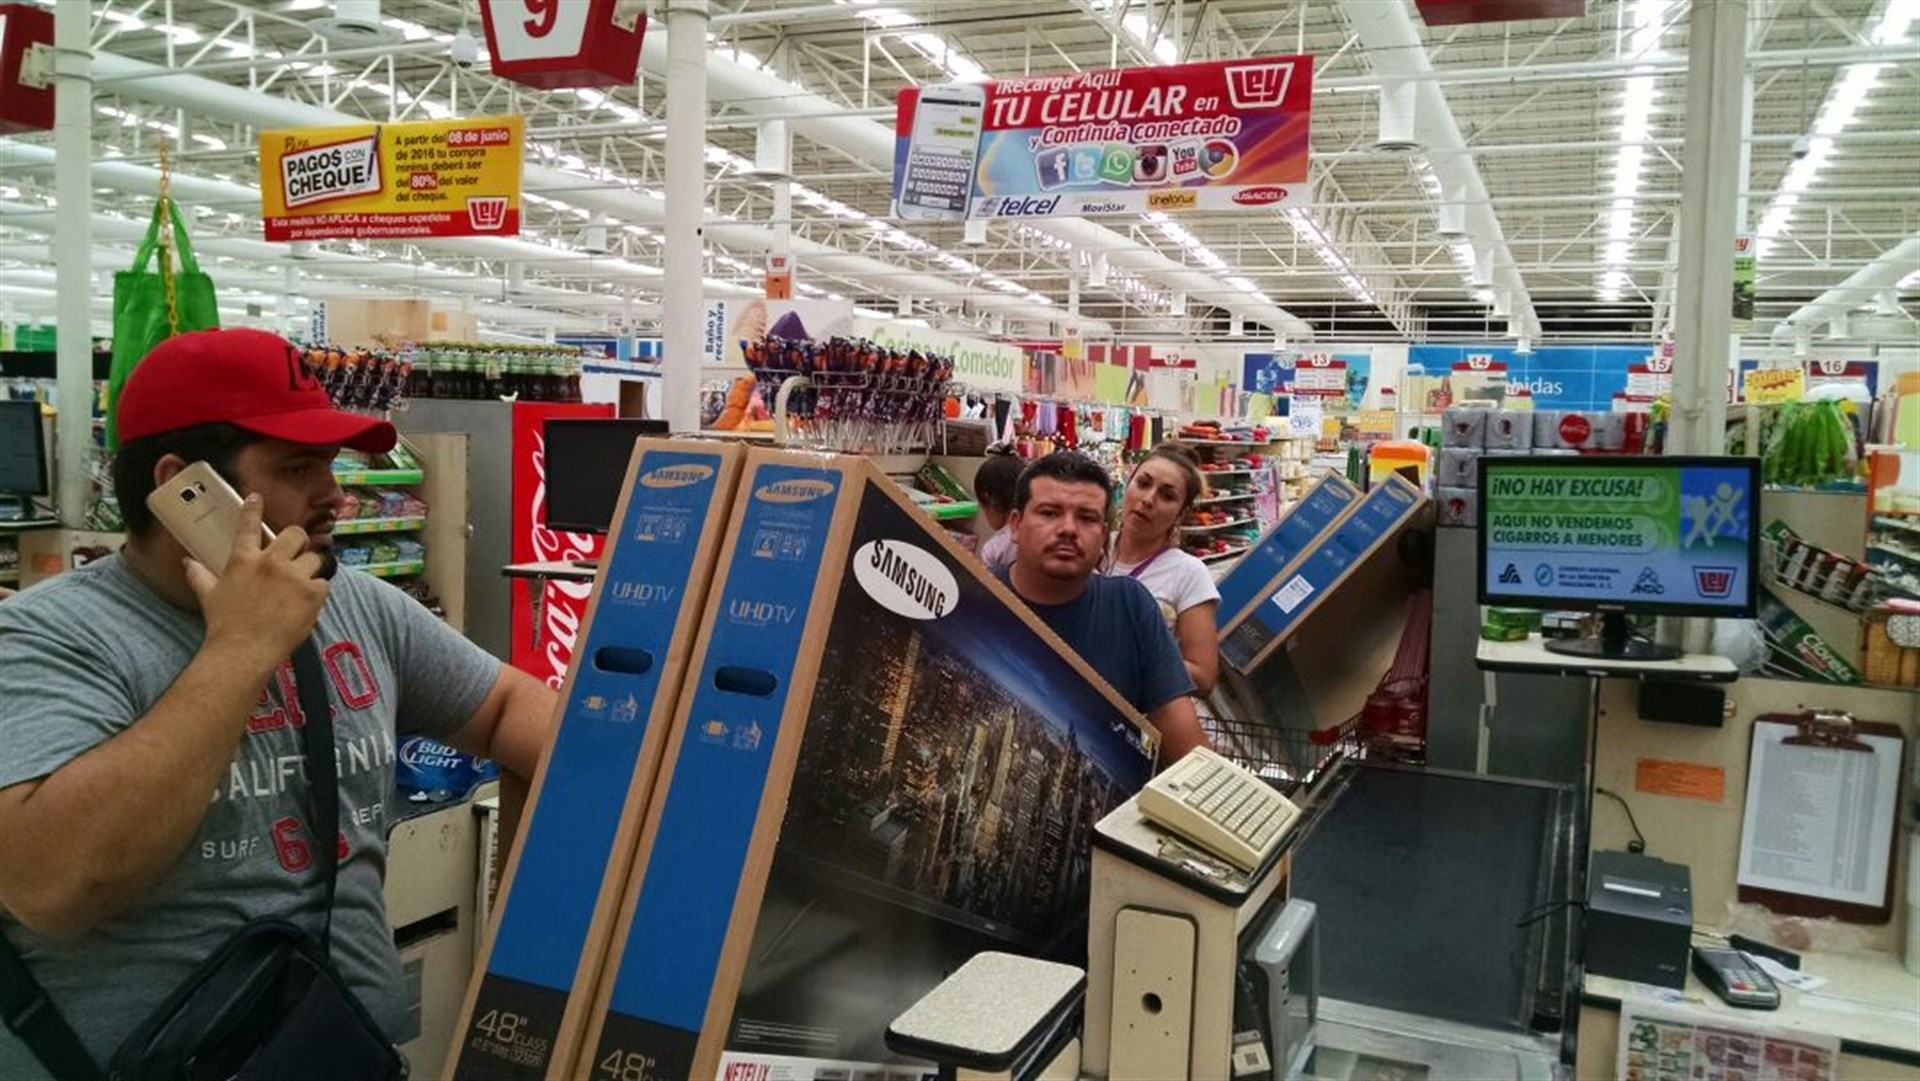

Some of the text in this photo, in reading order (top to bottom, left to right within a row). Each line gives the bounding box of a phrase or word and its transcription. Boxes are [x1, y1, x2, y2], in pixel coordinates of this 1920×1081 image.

[992, 96, 1031, 127] TU
[1040, 85, 1187, 123] CELULAR
[1193, 95, 1219, 112] en
[464, 131, 479, 141] de
[480, 129, 509, 144] junio
[1031, 135, 1044, 150] y
[1131, 115, 1239, 142] conectado
[344, 149, 366, 161] CON
[396, 148, 486, 160] de 2016 tu compra
[1173, 148, 1195, 160] You
[466, 161, 482, 169] ser
[396, 175, 478, 188] del 80% del valor
[396, 191, 409, 202] del
[997, 195, 1062, 216] telcel
[1313, 353, 1328, 365] 13
[1472, 356, 1488, 367] 14
[1650, 359, 1668, 370] 15
[1823, 360, 1842, 372] 16
[650, 469, 704, 482] SAMSUNG
[763, 485, 826, 498] SAMSUNG
[1531, 479, 1567, 497] HAY
[1570, 479, 1645, 497] EXCUSA!
[1531, 516, 1553, 529] NO
[1556, 517, 1634, 531] VENDEMOS
[1493, 531, 1644, 547] CIGARROS A MENORES
[871, 540, 946, 619] SAMSUNG
[417, 741, 457, 757] BUD
[409, 752, 464, 769] LIGHT
[202, 837, 260, 858] SURF
